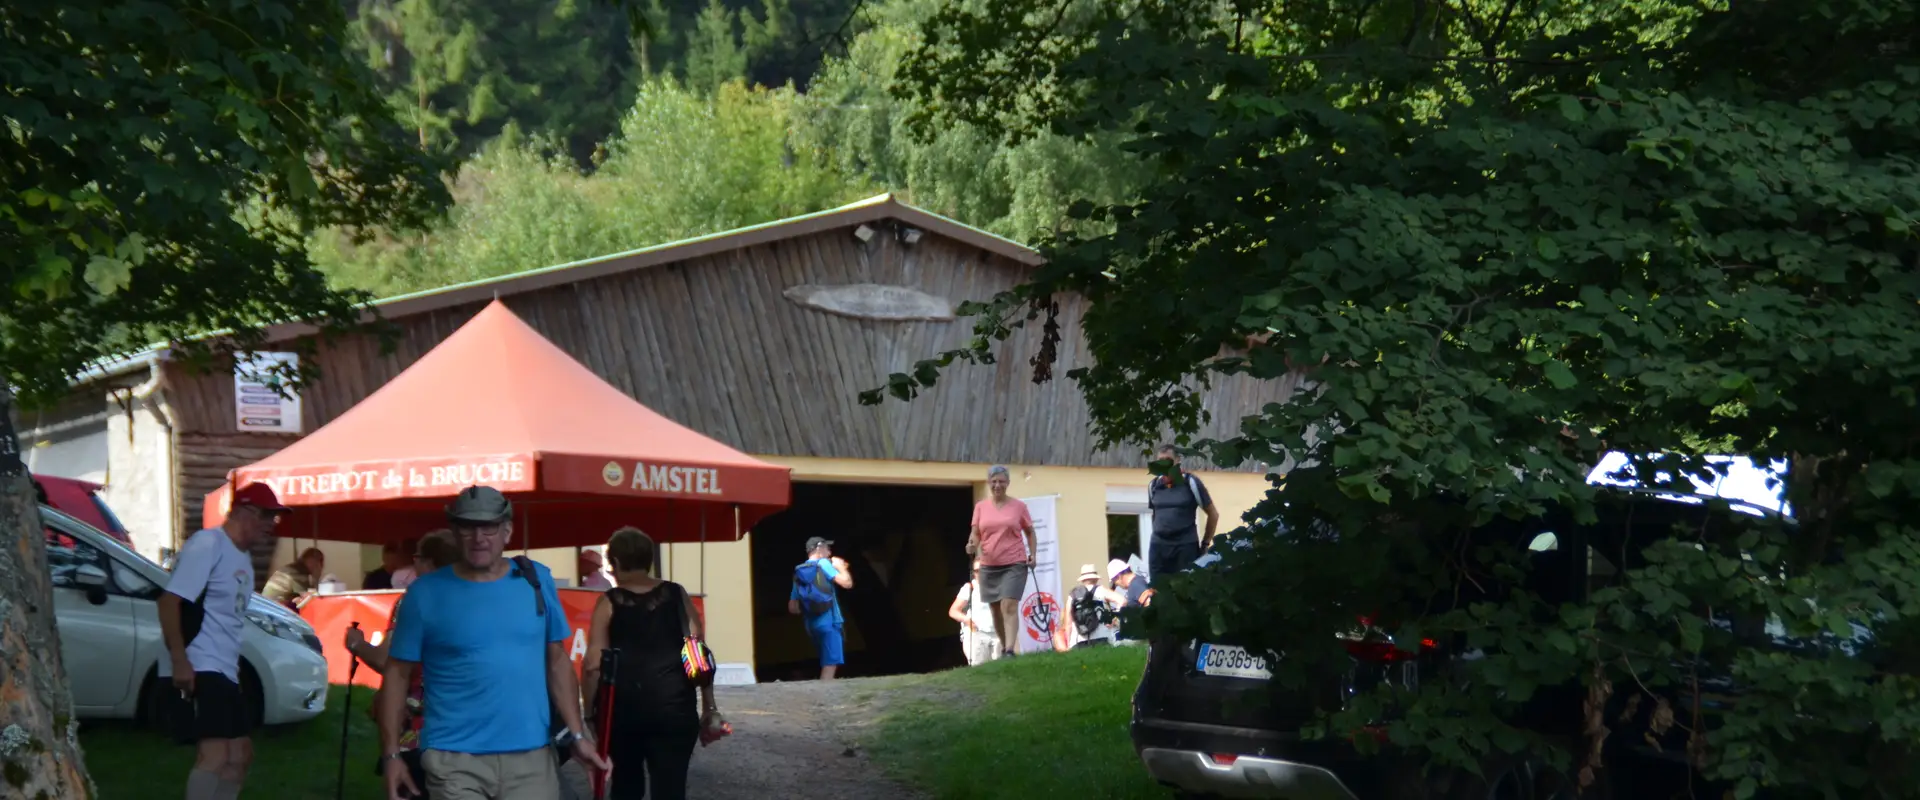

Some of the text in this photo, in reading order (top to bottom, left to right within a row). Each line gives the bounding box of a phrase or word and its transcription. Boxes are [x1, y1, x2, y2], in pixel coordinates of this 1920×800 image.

[256, 461, 523, 496] NTREPOT de la BRUCHE
[631, 461, 722, 495] AMSTEL
